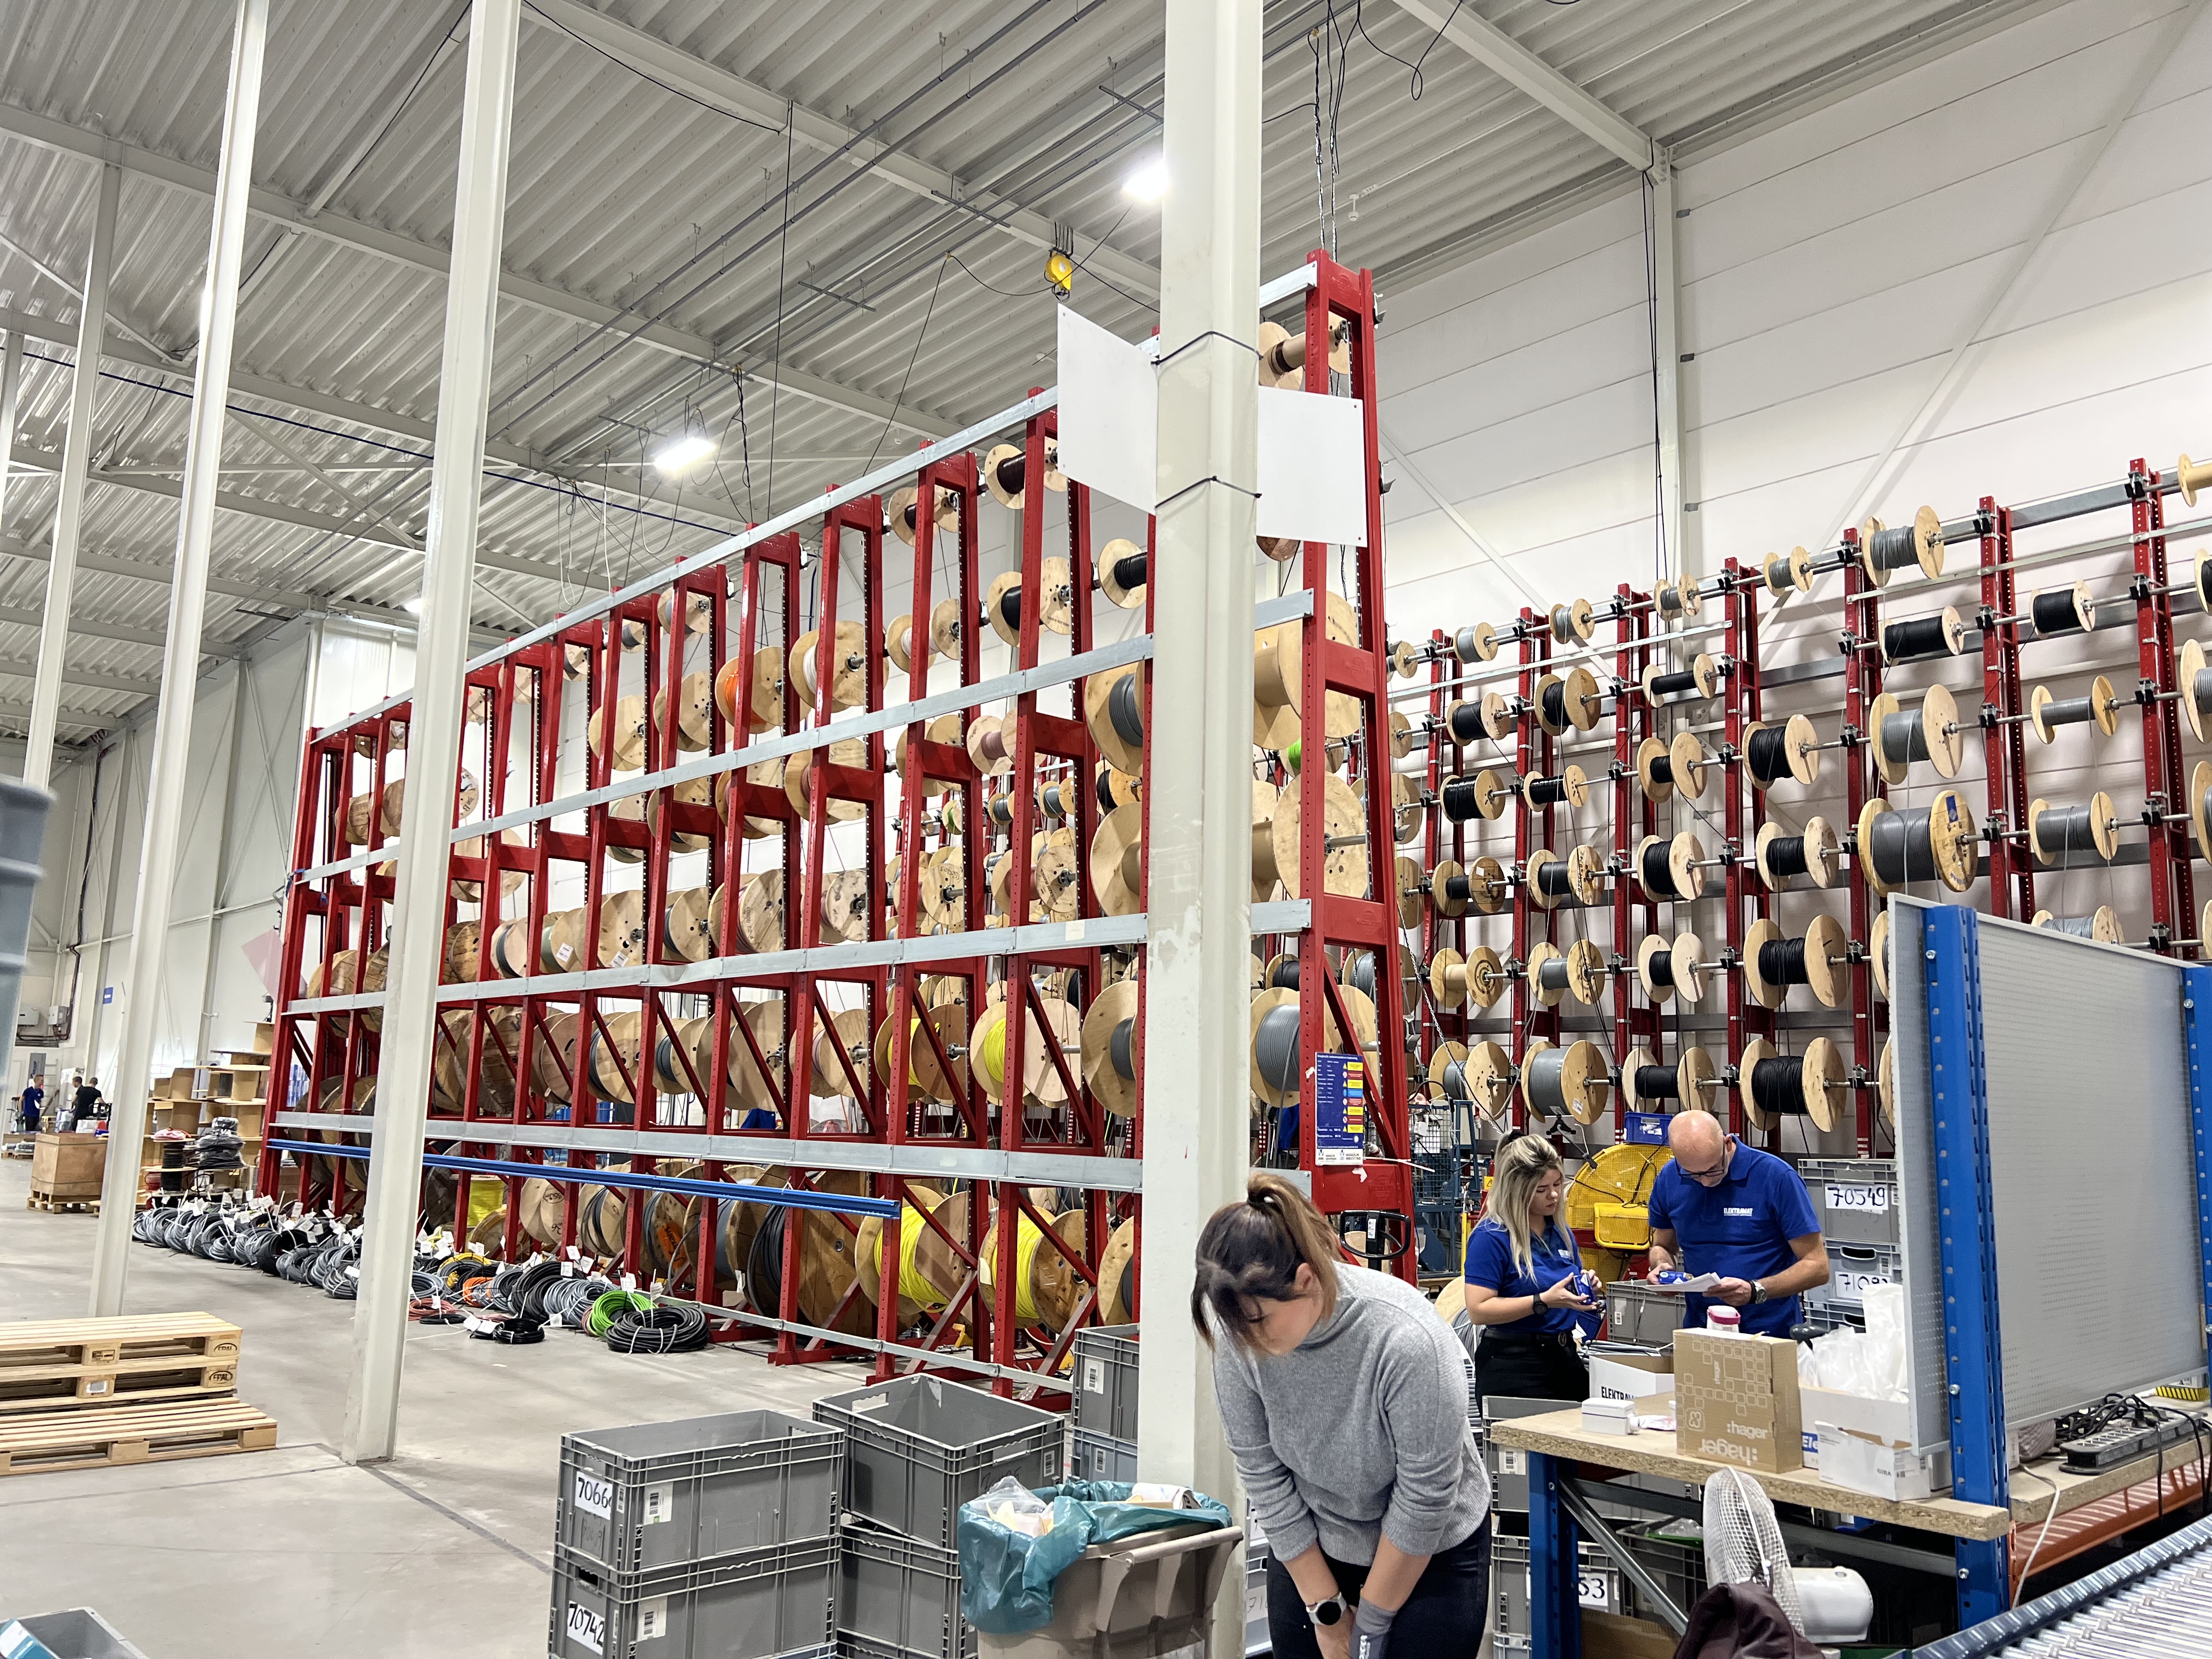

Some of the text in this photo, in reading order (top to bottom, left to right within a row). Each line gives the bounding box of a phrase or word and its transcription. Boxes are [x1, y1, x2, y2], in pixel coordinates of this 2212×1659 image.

[1827, 1187, 1885, 1206] 70549
[1877, 1468, 1892, 1476] GIRA
[569, 1603, 604, 1647] 70742
